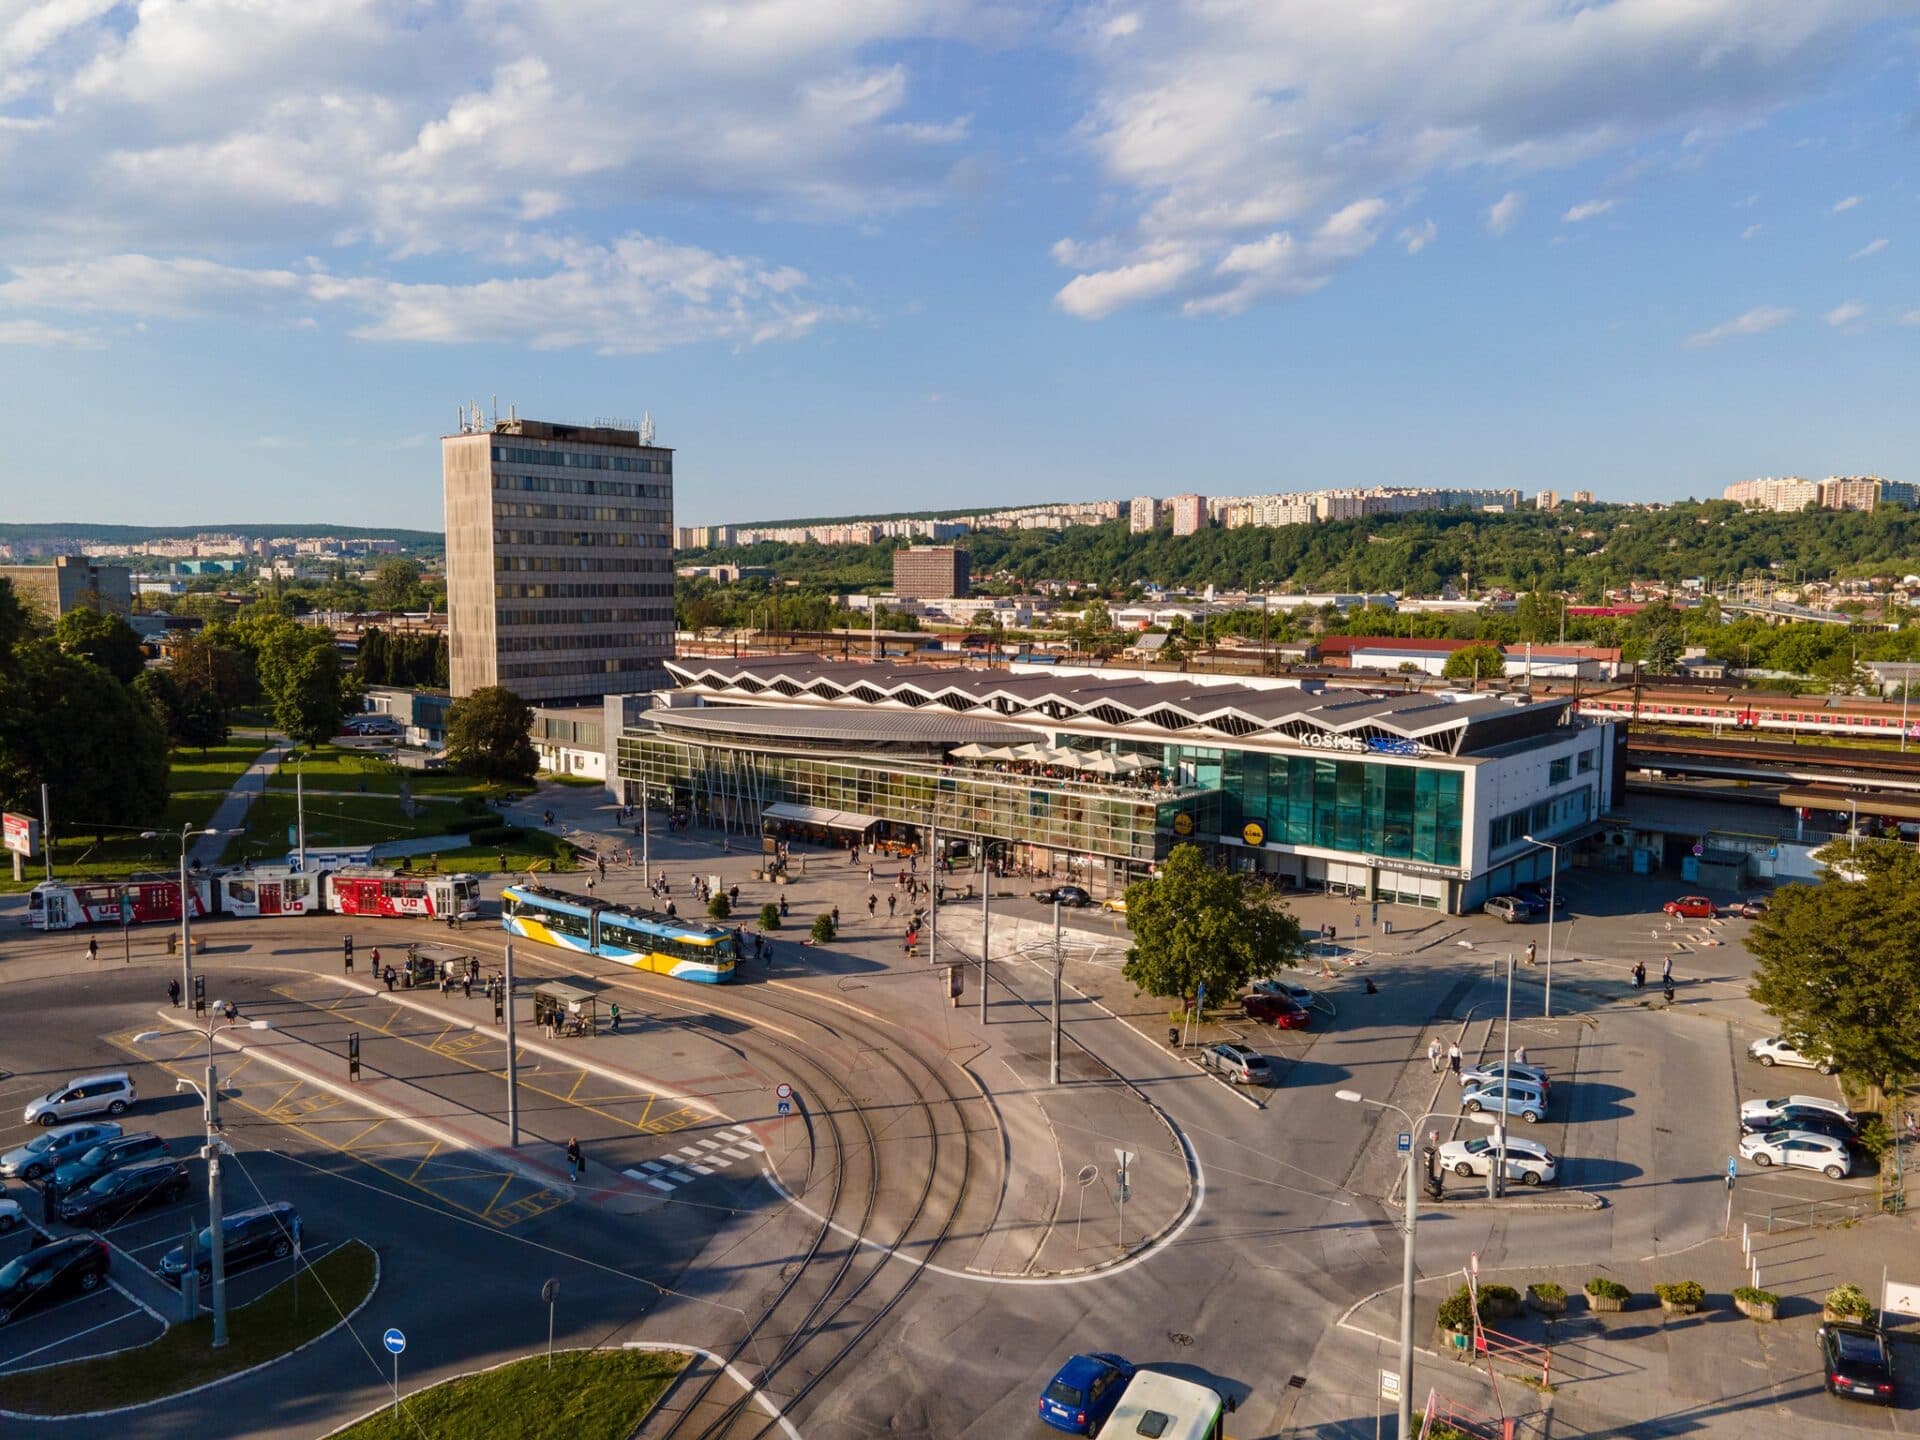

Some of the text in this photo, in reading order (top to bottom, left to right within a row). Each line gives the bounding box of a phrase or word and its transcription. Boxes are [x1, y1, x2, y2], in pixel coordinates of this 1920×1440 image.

[1298, 731, 1362, 752] KOŠICE
[647, 1108, 702, 1134] BUS
[495, 1189, 562, 1223] BUS
